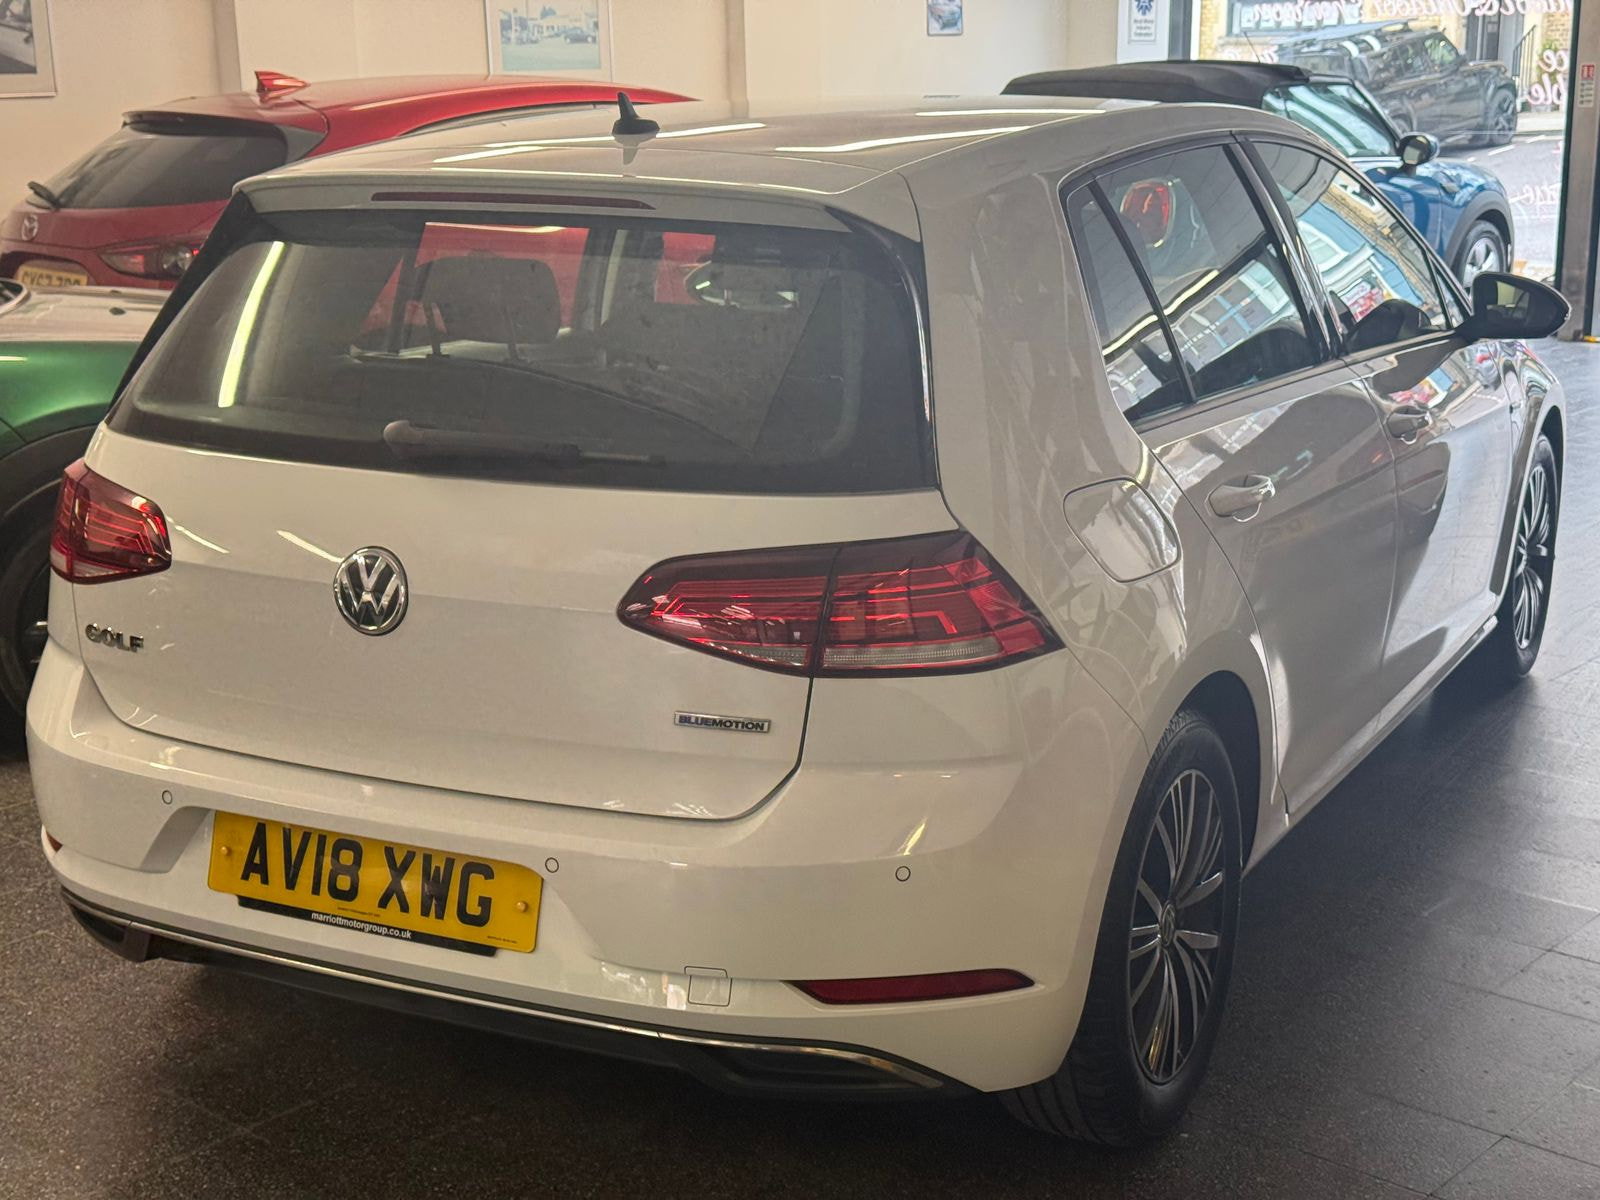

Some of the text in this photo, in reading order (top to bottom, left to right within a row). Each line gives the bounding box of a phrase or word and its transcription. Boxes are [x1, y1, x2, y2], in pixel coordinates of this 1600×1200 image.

[85, 623, 144, 653] GOLF
[678, 714, 765, 731] BLUEMOTION
[240, 821, 495, 928] AV18 XWG
[311, 911, 412, 940] marriottmotorgroup.co.uk
